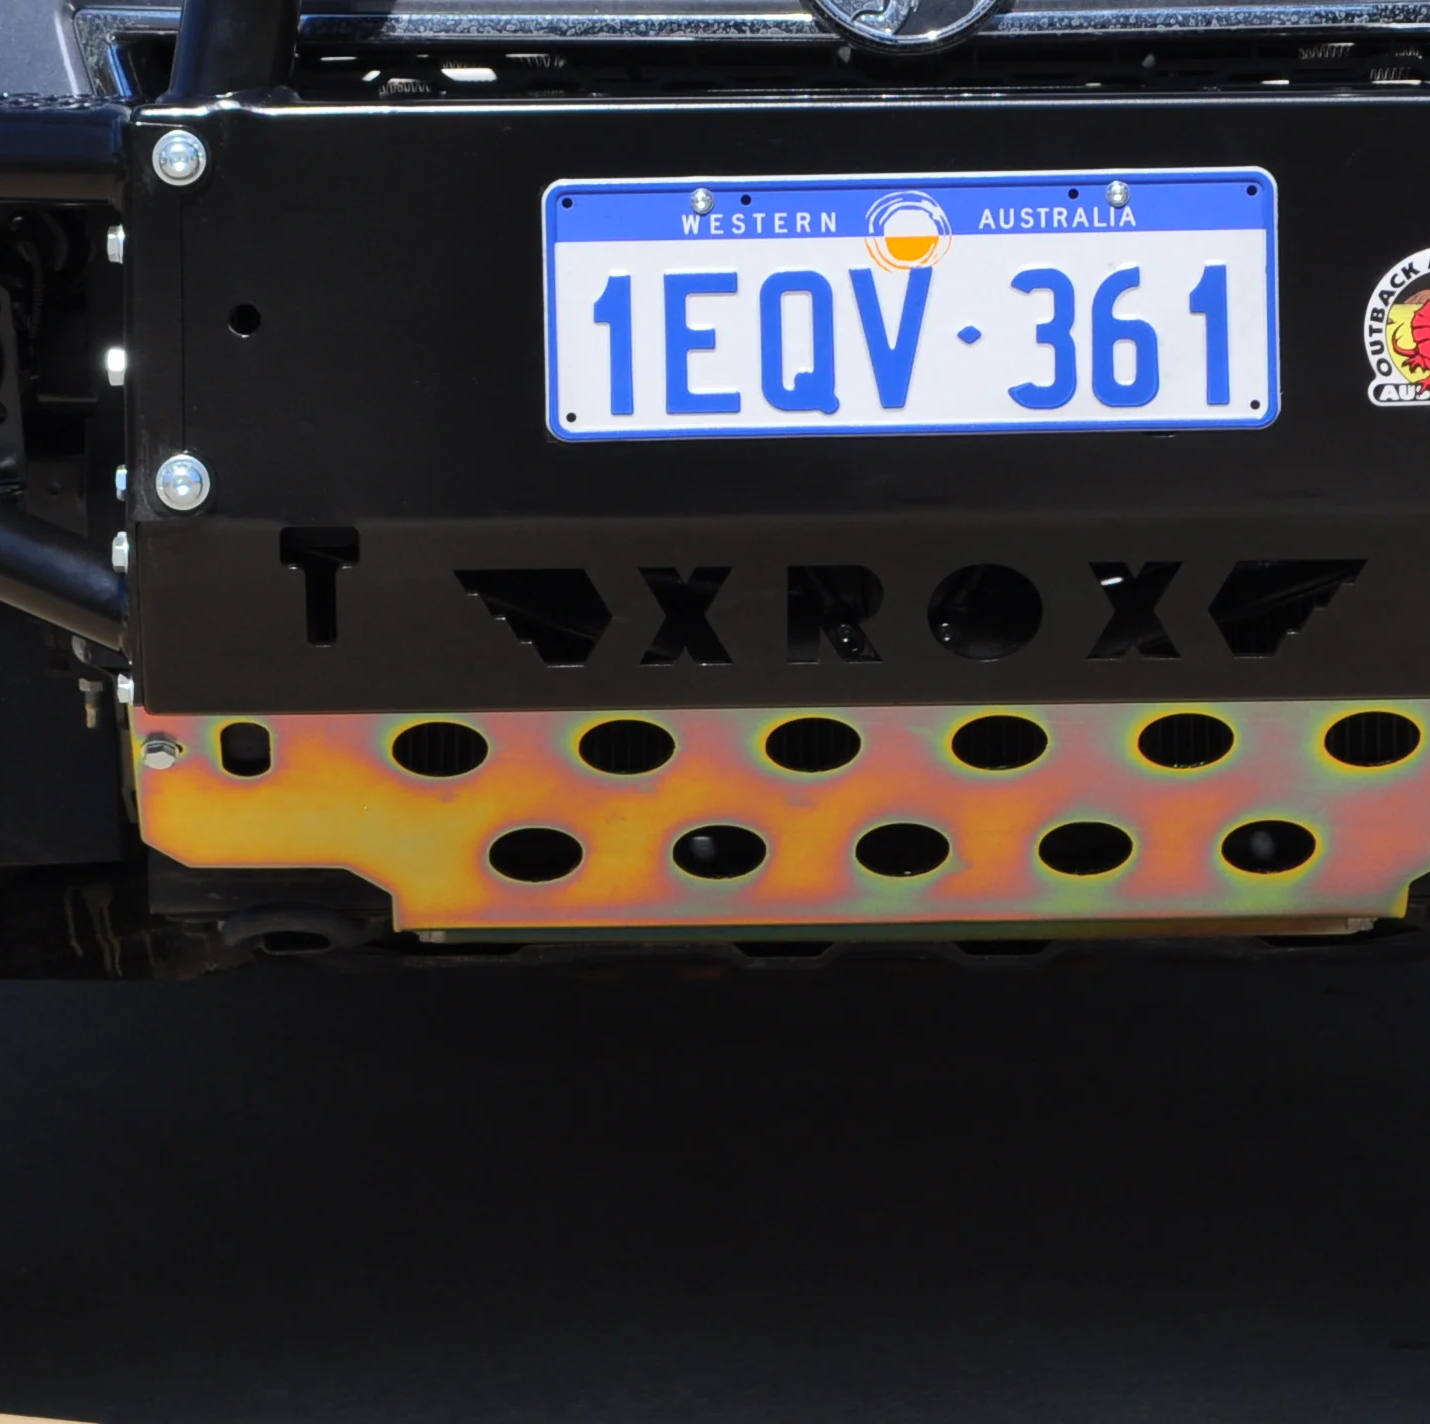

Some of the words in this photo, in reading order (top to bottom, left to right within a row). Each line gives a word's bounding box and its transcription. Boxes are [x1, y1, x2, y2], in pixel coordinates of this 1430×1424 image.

[680, 211, 838, 236] WESTERN
[977, 205, 1138, 231] AUSTRALIA
[1368, 260, 1421, 377] OUTBACK
[636, 561, 1183, 667] XROX
